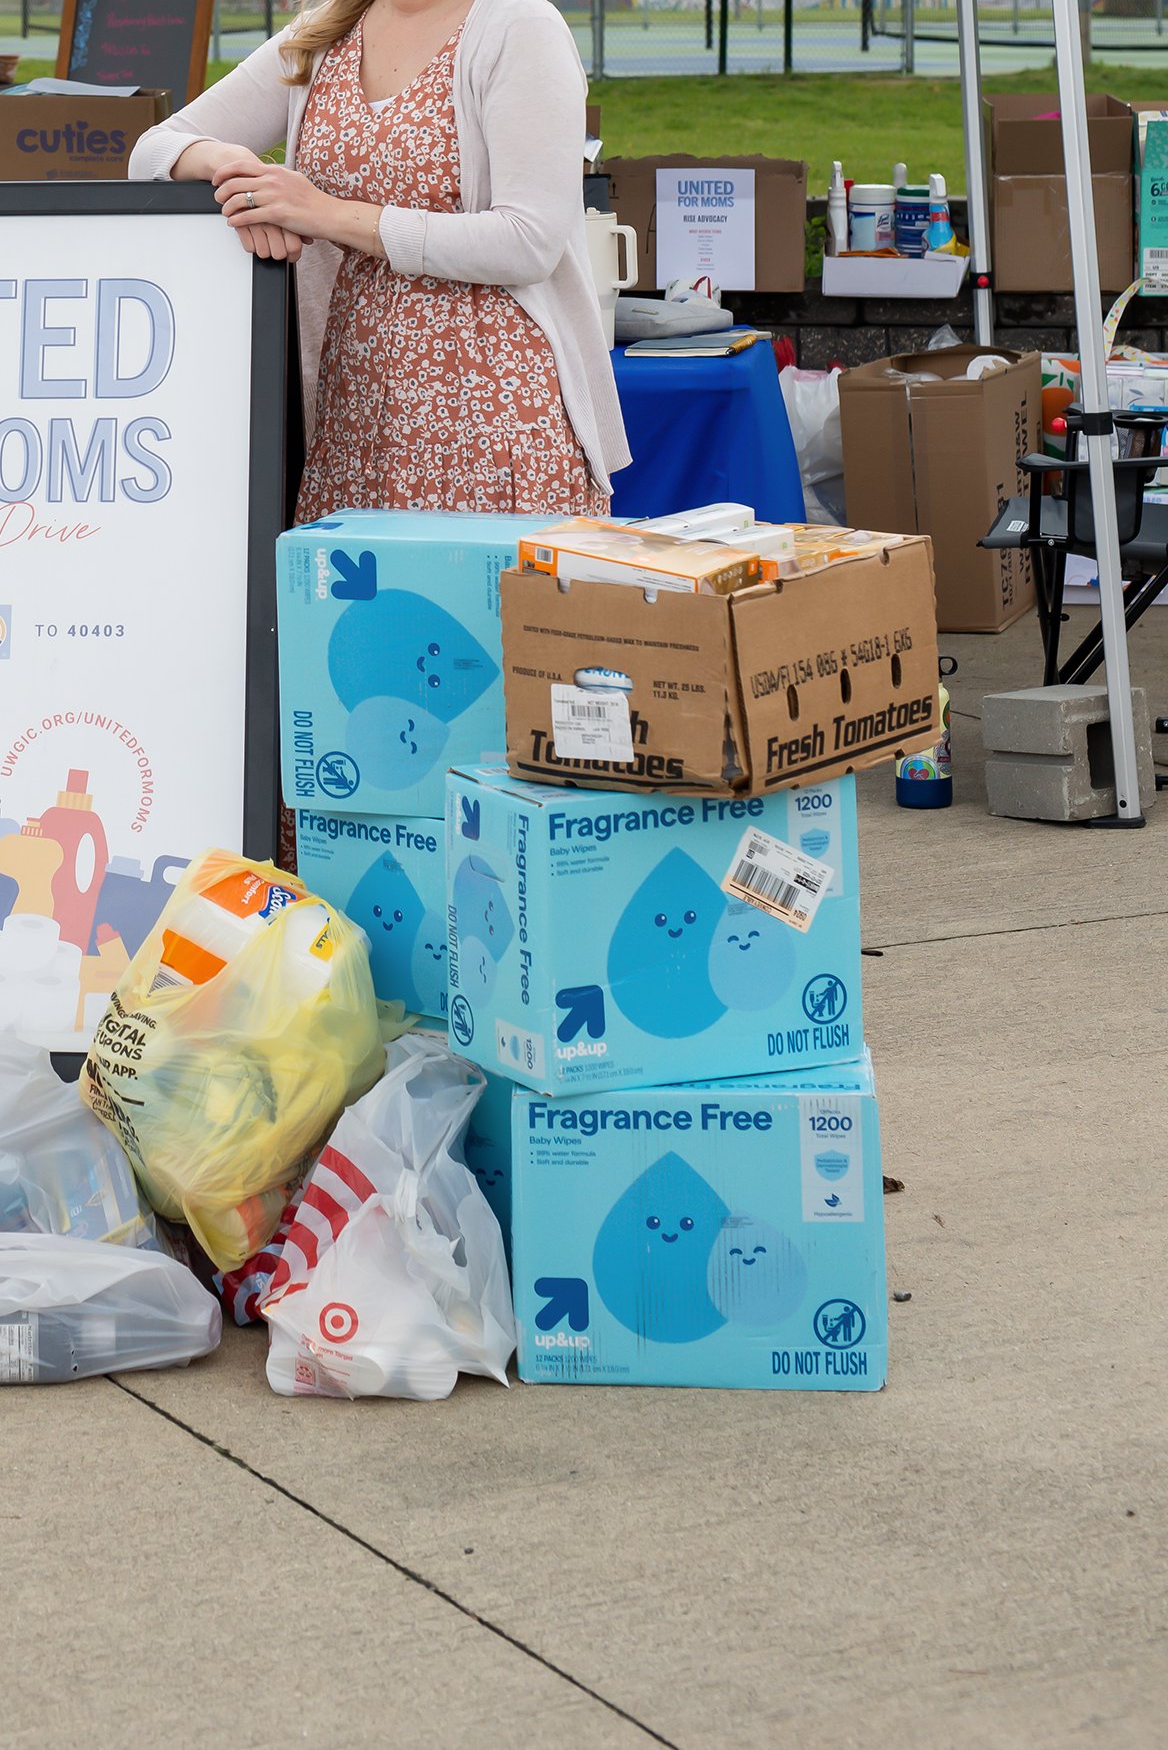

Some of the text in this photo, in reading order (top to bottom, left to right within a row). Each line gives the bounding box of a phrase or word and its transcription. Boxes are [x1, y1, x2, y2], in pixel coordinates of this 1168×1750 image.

[16, 120, 127, 154] cuties
[677, 180, 735, 195] UNITED
[677, 196, 735, 207] FOR MOMS
[683, 215, 728, 223] RISE ADVOCACY
[315, 548, 327, 600] up&up
[35, 624, 125, 637] TO 40403
[644, 640, 668, 648] MAINTAIN
[669, 643, 699, 651] FRESHNESS
[512, 666, 537, 677] PRODUCE
[538, 670, 545, 678] OF
[653, 680, 706, 693] NET WT. 25 LBS.
[666, 691, 679, 700] KG.
[767, 694, 933, 774] Fresh Tomatoes
[293, 710, 315, 798] DO NOT FLUSH
[0, 710, 155, 834] UWGIC.ORG/UNITEDFORMOMS
[795, 794, 832, 812] 1200
[548, 797, 765, 842] Fragrance Free
[299, 809, 437, 852] Fragrance Free
[300, 834, 327, 845] Baby Wipes
[550, 843, 597, 856] Baby Wipes
[516, 814, 532, 1006] Fragrance Free
[448, 905, 459, 988] DO NOT FLUSH
[767, 1023, 850, 1056] DO NOT FLUSH
[557, 1041, 607, 1061] up&up
[112, 1062, 138, 1080] APP.
[528, 1102, 773, 1136] Fragrance Free
[808, 1116, 853, 1131] 1200
[529, 1136, 582, 1146] Baby Wipes
[536, 1158, 550, 1166] Soft
[565, 1158, 589, 1166] durable
[535, 1332, 590, 1350] up&up
[543, 1354, 563, 1362] PACKS
[772, 1351, 867, 1375] DO NOT FLUSH
